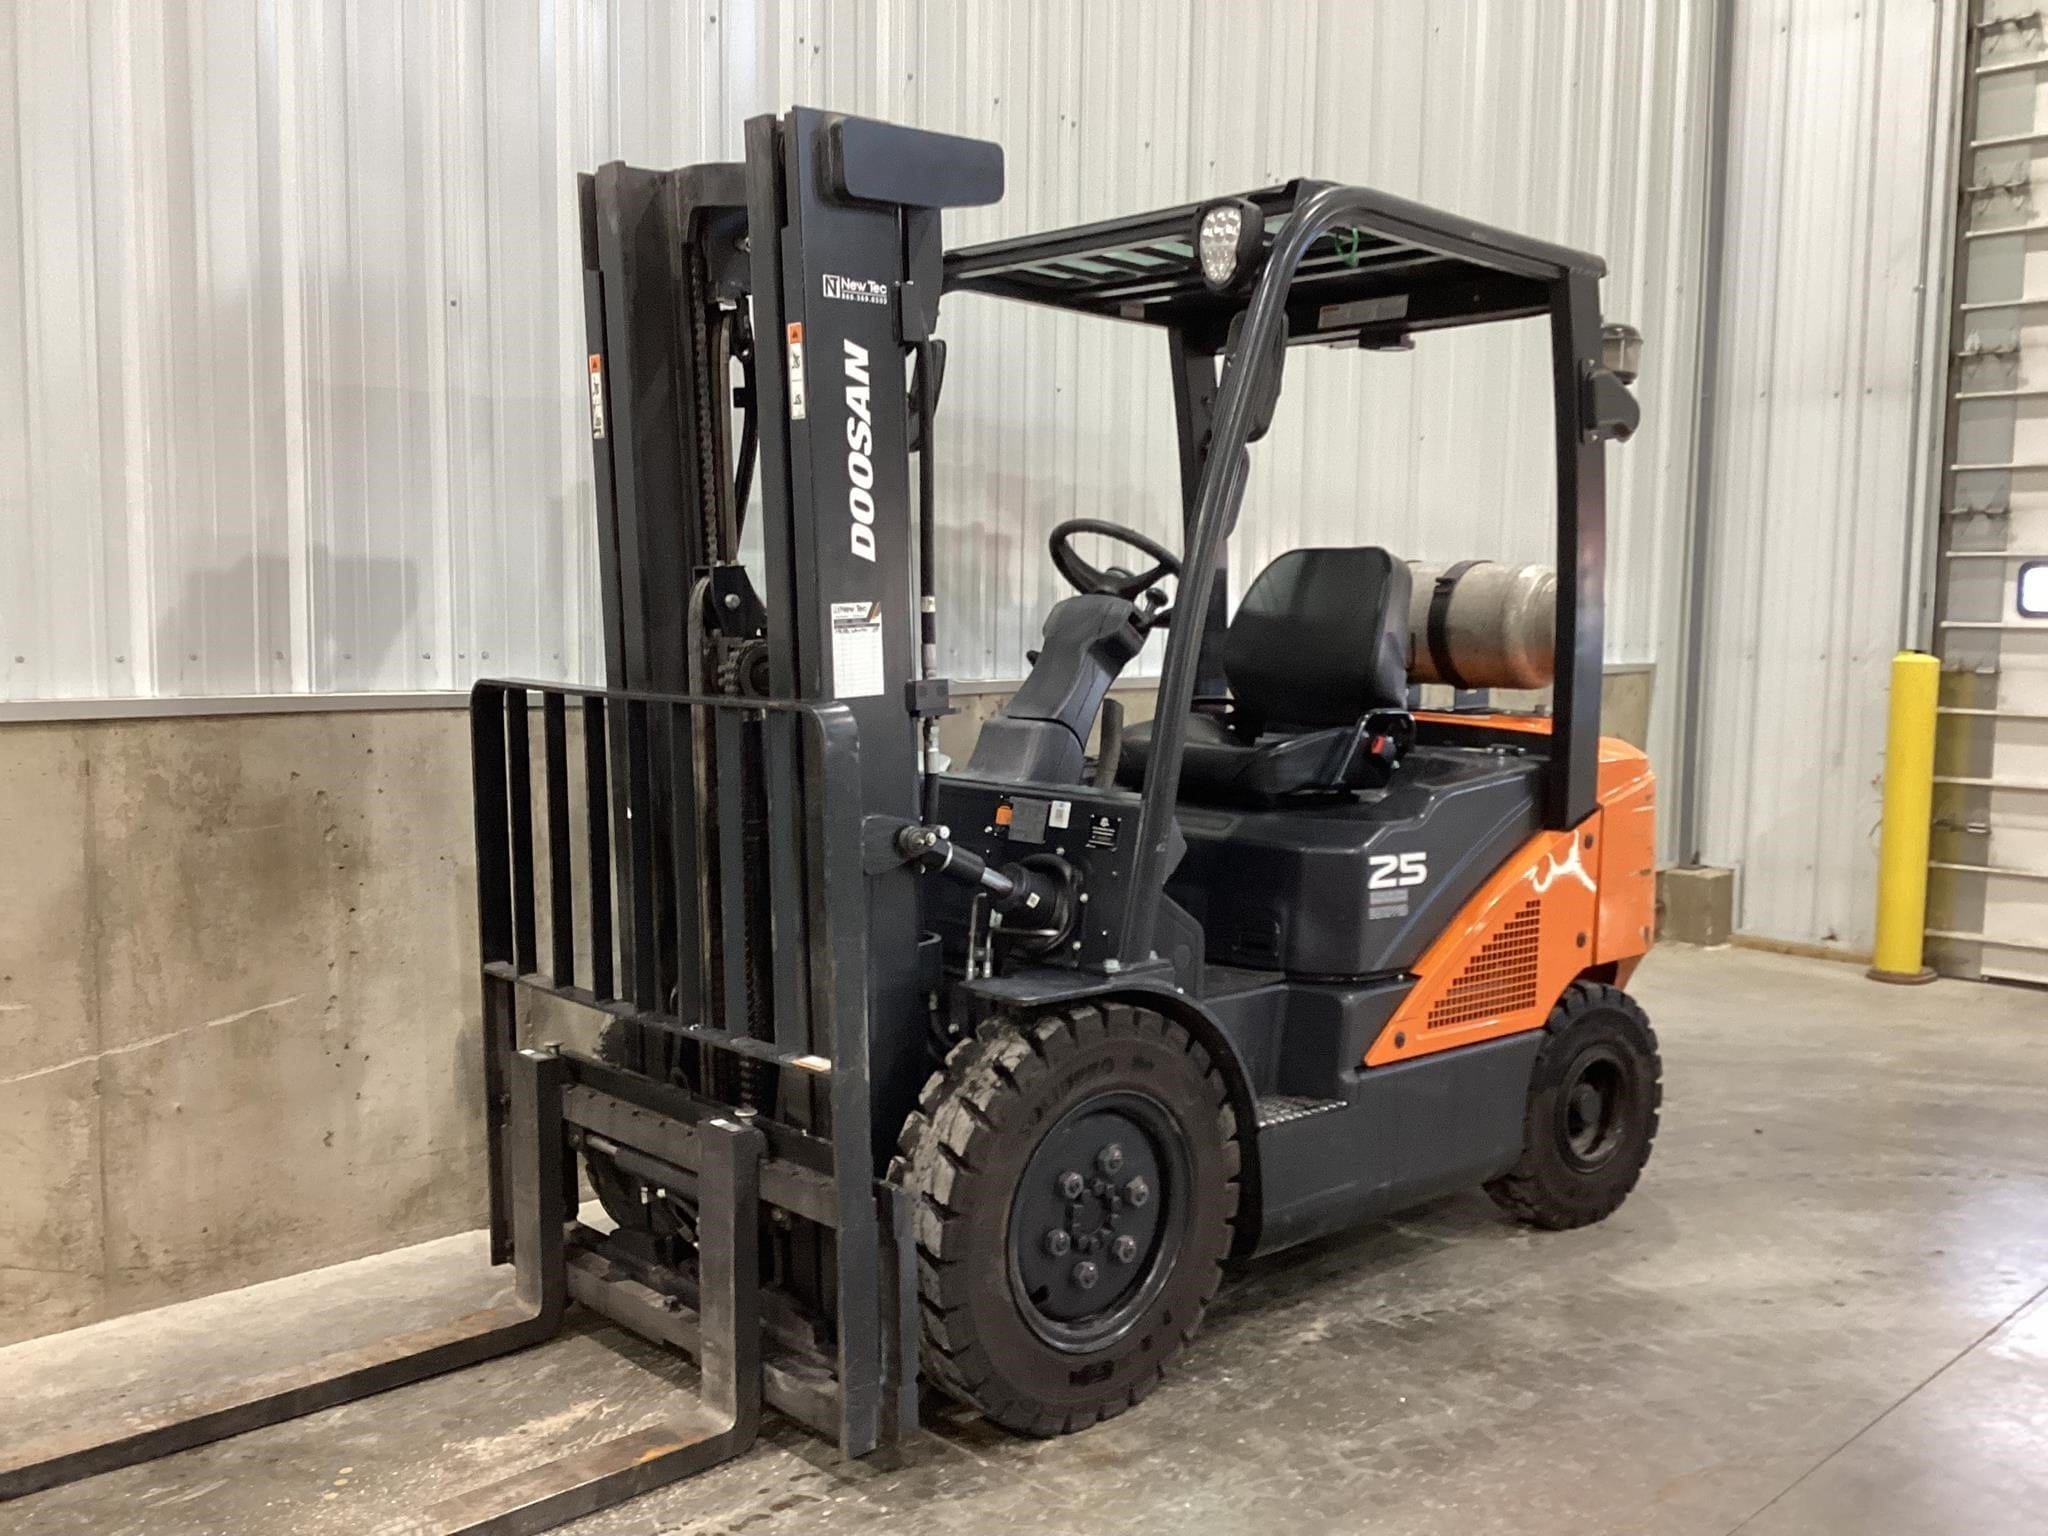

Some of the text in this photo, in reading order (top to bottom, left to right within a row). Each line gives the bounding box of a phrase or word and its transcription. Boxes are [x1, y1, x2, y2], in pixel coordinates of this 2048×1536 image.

[841, 277, 866, 291] New
[867, 280, 887, 294] Tec
[843, 338, 876, 562] DOOSAN
[1368, 852, 1427, 889] 25
